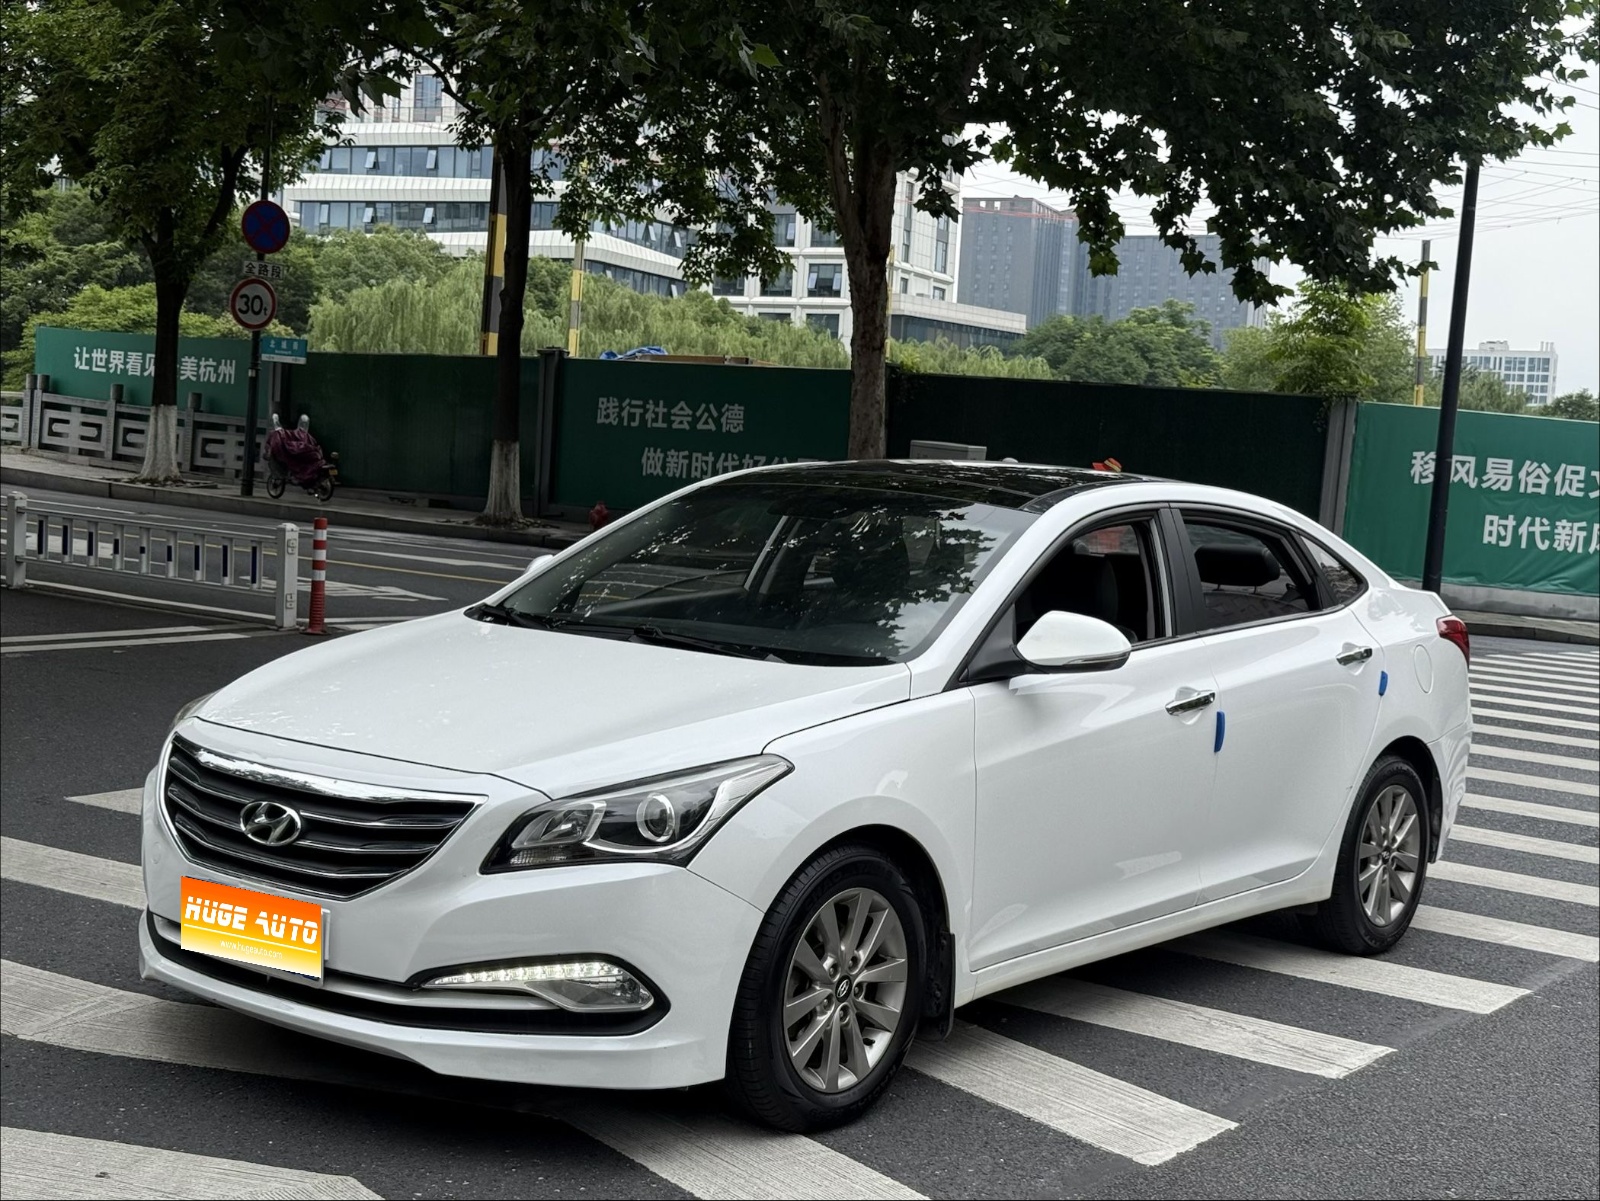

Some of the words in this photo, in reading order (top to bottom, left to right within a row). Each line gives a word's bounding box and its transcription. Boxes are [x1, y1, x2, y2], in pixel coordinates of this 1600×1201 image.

[244, 262, 281, 278] 全路段
[74, 346, 236, 384] 让世界看见美杭州
[597, 397, 744, 433] 践行社会公德
